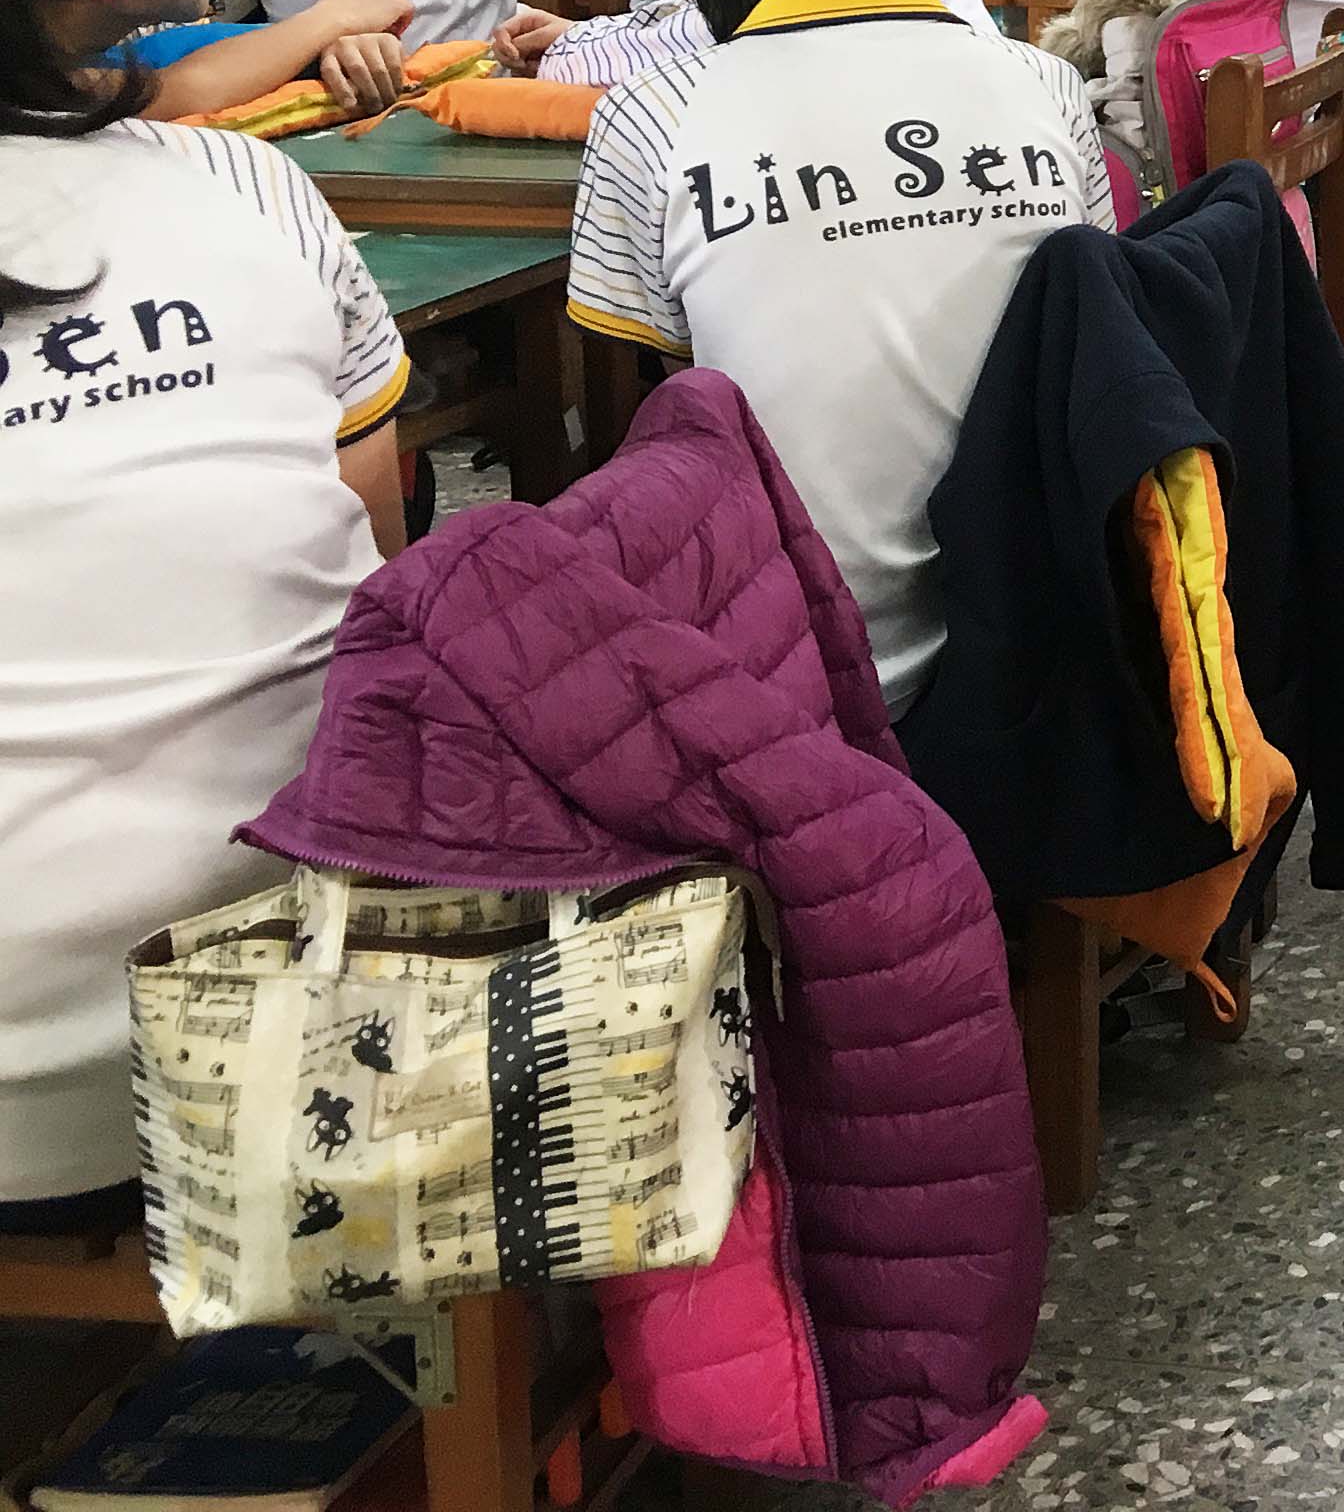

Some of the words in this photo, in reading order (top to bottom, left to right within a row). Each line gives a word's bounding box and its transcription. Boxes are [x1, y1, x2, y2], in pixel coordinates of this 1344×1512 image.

[683, 152, 858, 242] Lin
[884, 119, 1066, 199] Sen
[822, 205, 984, 242] elementary
[990, 198, 1068, 219] school
[0, 299, 214, 387] en
[84, 362, 215, 408] school
